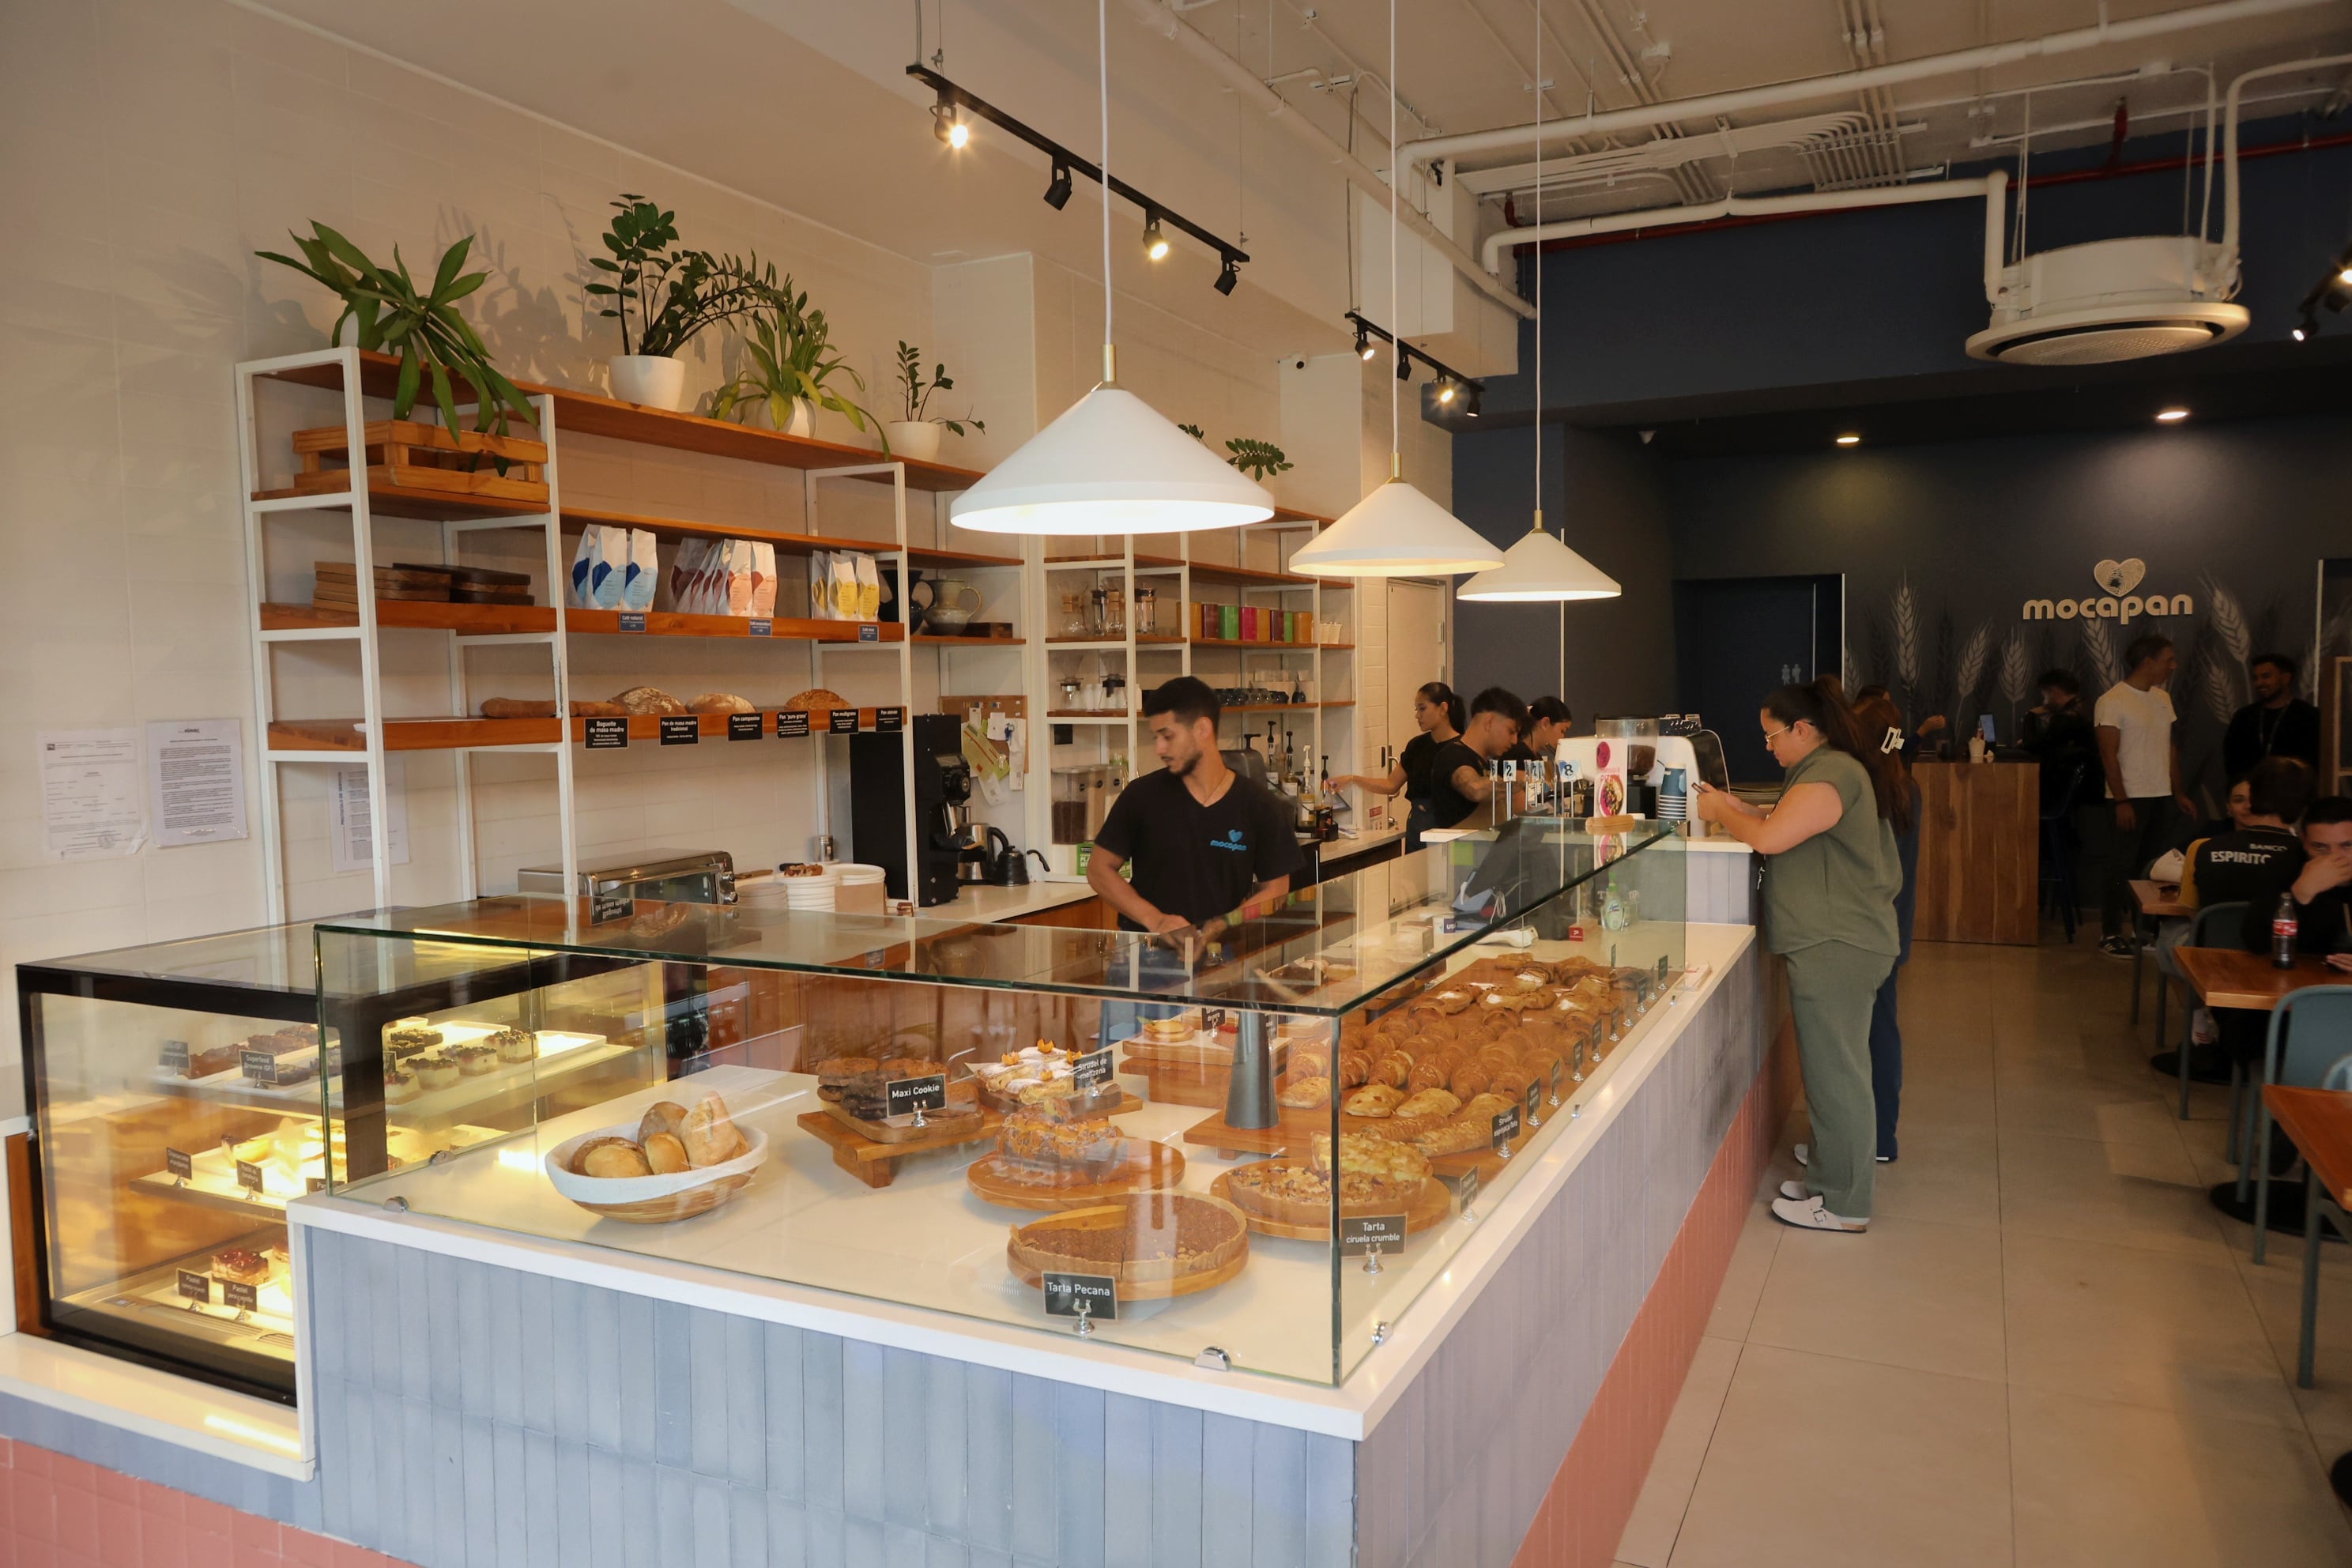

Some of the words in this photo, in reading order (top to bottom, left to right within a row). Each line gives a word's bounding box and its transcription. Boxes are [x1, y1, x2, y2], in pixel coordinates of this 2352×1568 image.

[2022, 594, 2193, 625] mocapan
[1506, 764, 1512, 777] 2
[1565, 764, 1574, 776] 8
[891, 1087, 911, 1099] Maxi
[913, 1084, 940, 1095] Cookie
[1363, 1222, 1385, 1232] Tarta
[1346, 1234, 1370, 1243] ciruela
[1371, 1233, 1400, 1242] crumble
[1047, 1281, 1072, 1293] Tarta
[1074, 1283, 1110, 1296] Pecana
